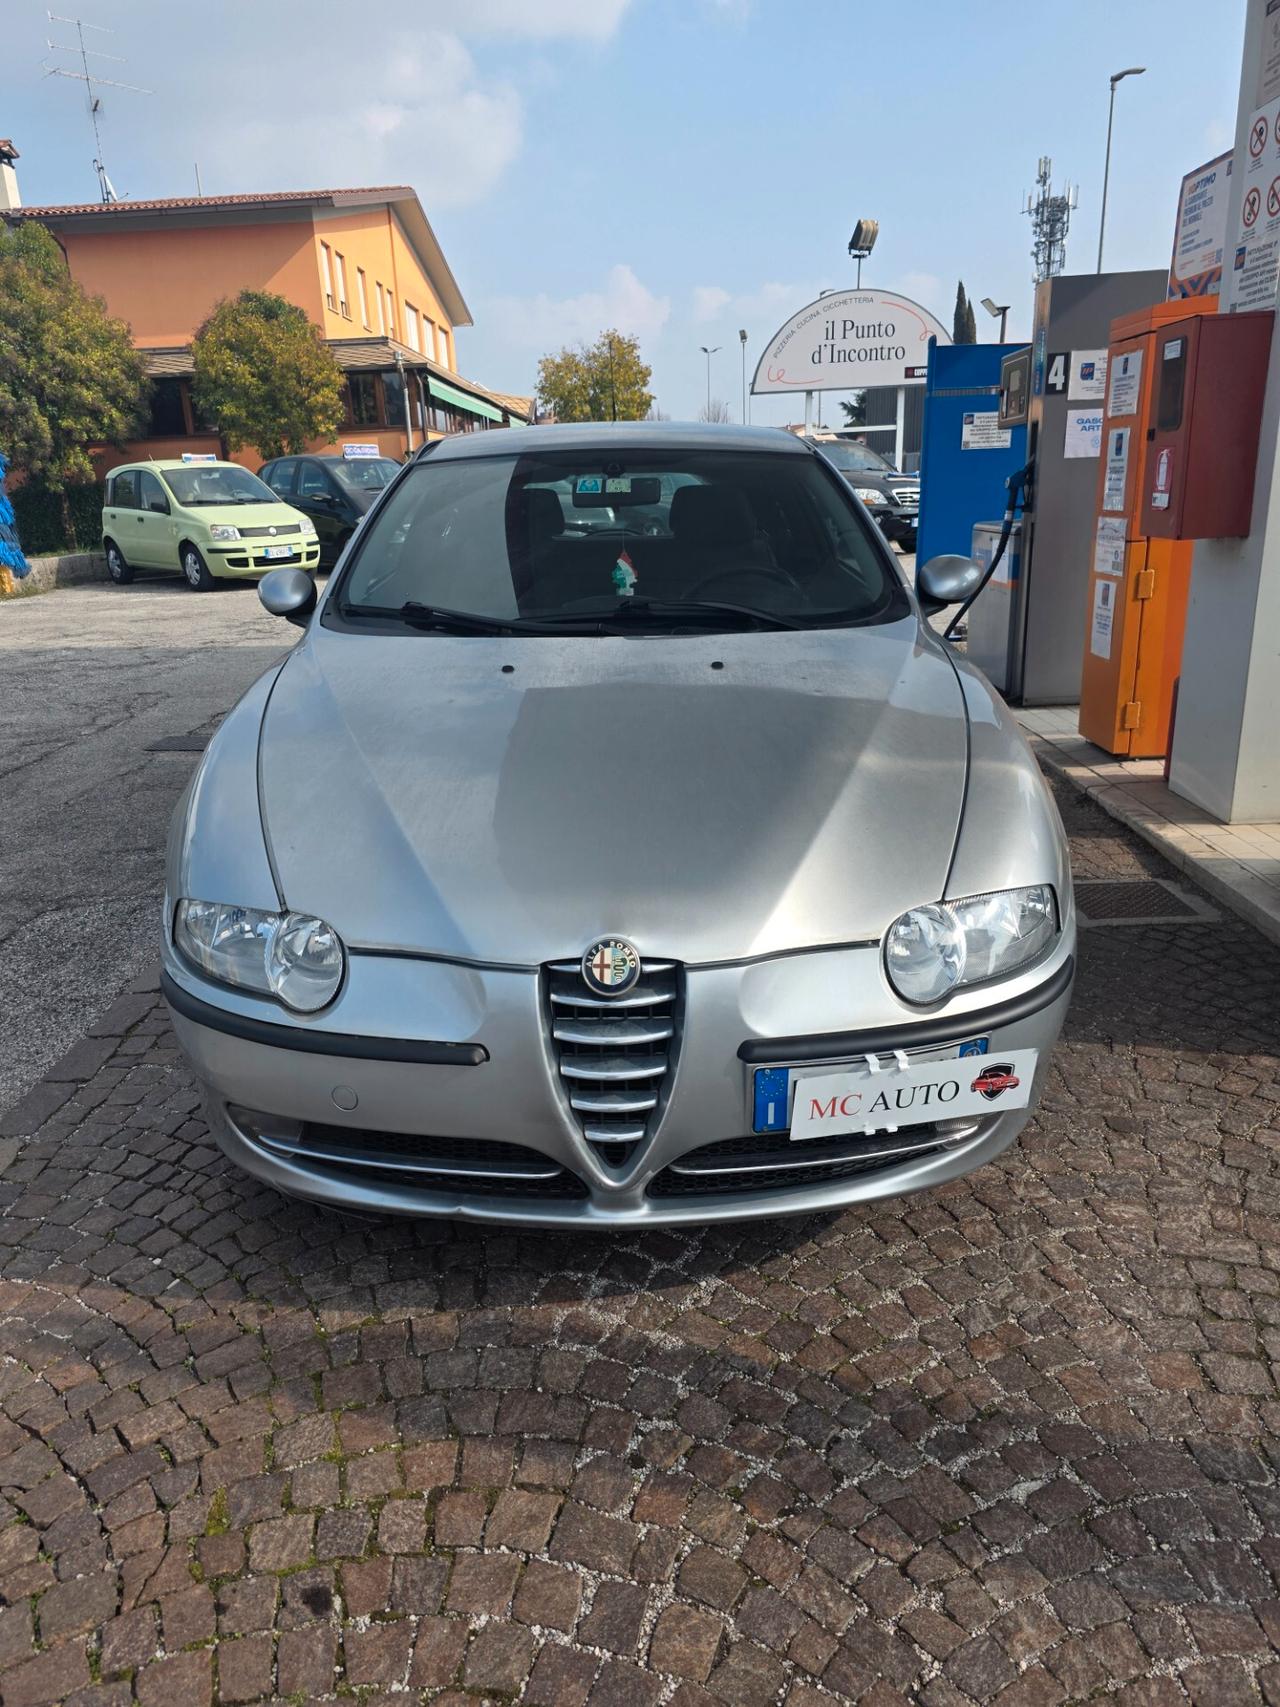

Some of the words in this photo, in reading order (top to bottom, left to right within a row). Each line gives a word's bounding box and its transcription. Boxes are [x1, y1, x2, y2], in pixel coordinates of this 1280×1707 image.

[773, 329, 796, 359] PIZZERIA
[797, 310, 821, 329] CUCINA
[822, 297, 874, 312] CICCHETTERIA
[824, 320, 835, 340] il
[841, 320, 896, 339] Punto
[811, 343, 906, 364] d'Incontro
[1048, 355, 1065, 391] 4
[586, 943, 605, 967] ALFA
[610, 941, 636, 968] ROMEO
[808, 1094, 863, 1120] MC
[869, 1080, 960, 1112] AUTO
